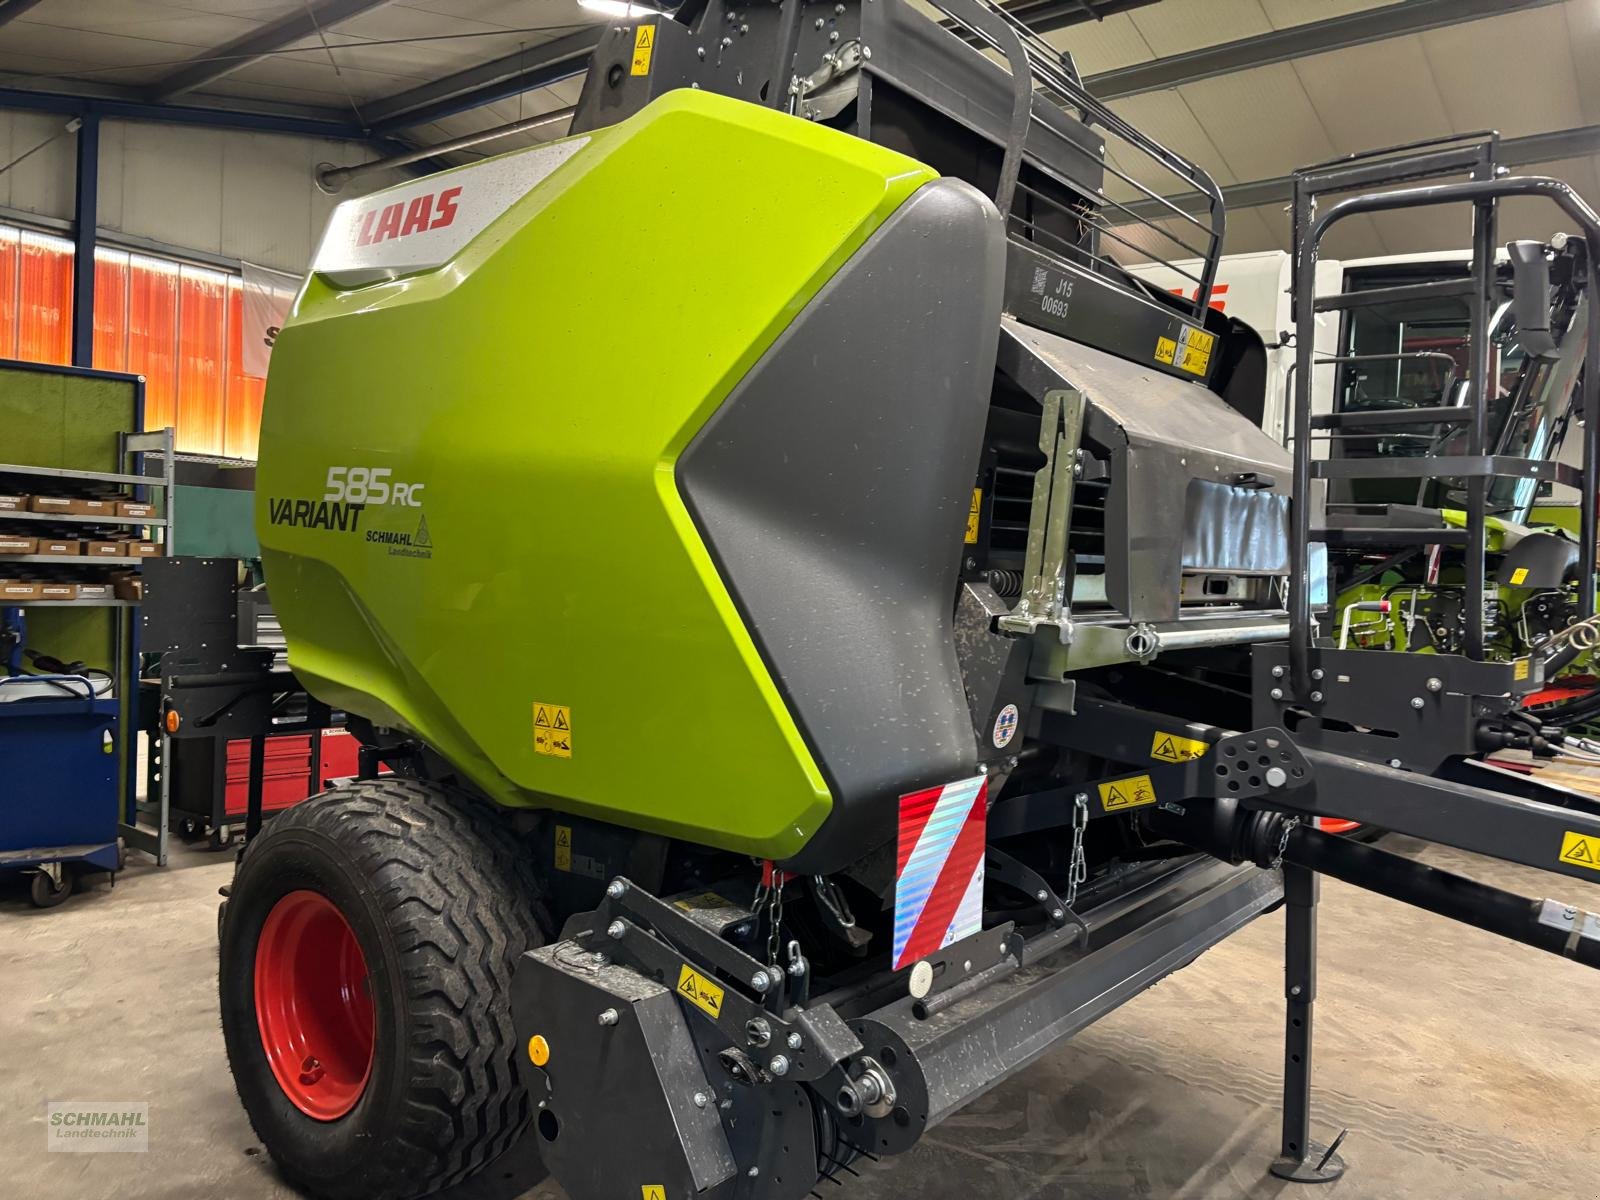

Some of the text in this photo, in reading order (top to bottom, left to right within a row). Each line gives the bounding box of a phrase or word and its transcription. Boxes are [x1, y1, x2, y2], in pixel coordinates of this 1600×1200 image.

[354, 186, 463, 247] LAAS
[1055, 279, 1073, 298] J15
[1041, 295, 1069, 318] 00693
[269, 498, 365, 532] VARIANT
[366, 530, 412, 546] SCHMAHL
